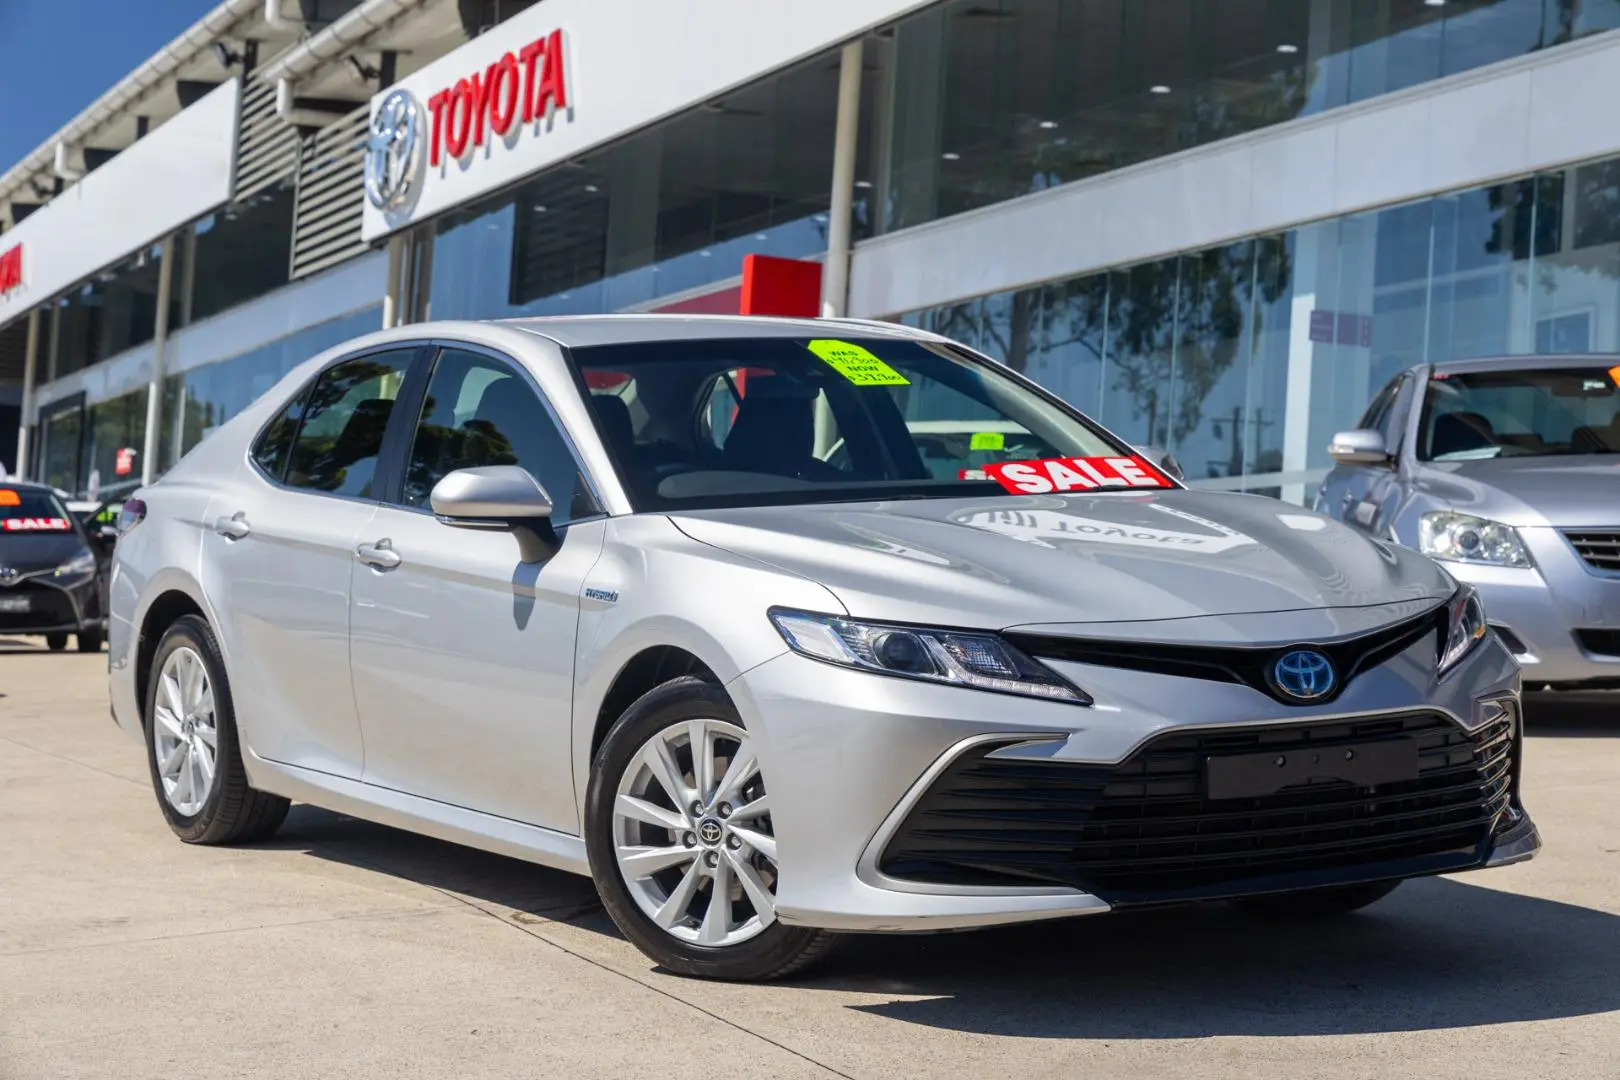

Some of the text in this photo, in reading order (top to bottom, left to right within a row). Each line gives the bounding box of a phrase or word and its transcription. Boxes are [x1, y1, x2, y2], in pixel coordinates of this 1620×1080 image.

[428, 28, 566, 167] TOYOTA
[1000, 457, 1160, 493] SALE
[7, 517, 66, 530] SALE
